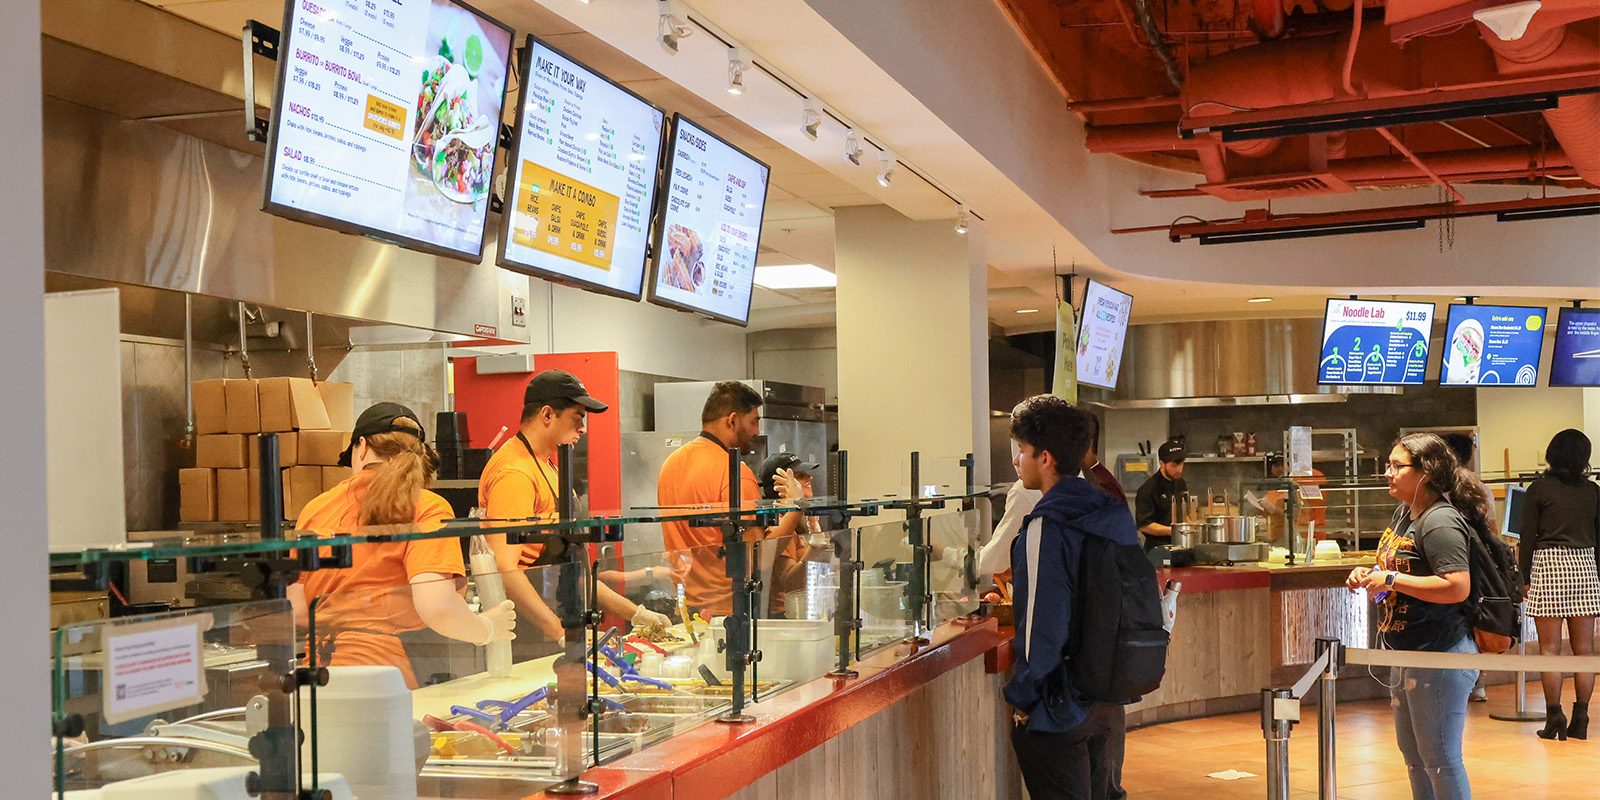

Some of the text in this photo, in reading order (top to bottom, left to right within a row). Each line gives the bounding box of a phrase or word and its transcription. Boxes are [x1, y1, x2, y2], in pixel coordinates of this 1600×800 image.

[300, 18, 315, 29] Cheese
[299, 28, 310, 37] $7.99
[341, 37, 353, 46] Veggie
[377, 52, 389, 62] Protein
[295, 67, 307, 77] Veggie
[296, 49, 361, 83] BURRITO BURRITO BOWL
[293, 76, 304, 84] $7.99
[536, 57, 586, 92] MAKE IT YOUR WAY
[334, 81, 347, 91] Protein
[289, 103, 310, 117] NACHOS
[287, 120, 296, 128] Chips
[680, 130, 706, 151] SNACKS/SIDES
[284, 147, 301, 160] SALAD
[550, 180, 595, 206] MAKE IT A COMBO
[552, 225, 560, 233] DRINK
[598, 239, 606, 247] DRINK
[1343, 306, 1385, 319] Noodle Lab
[1406, 310, 1427, 321] $11.99
[1396, 318, 1403, 332] 4
[1353, 337, 1361, 351] 2
[1415, 340, 1424, 357] 5
[1331, 347, 1338, 364] 1
[1371, 344, 1380, 362] 3
